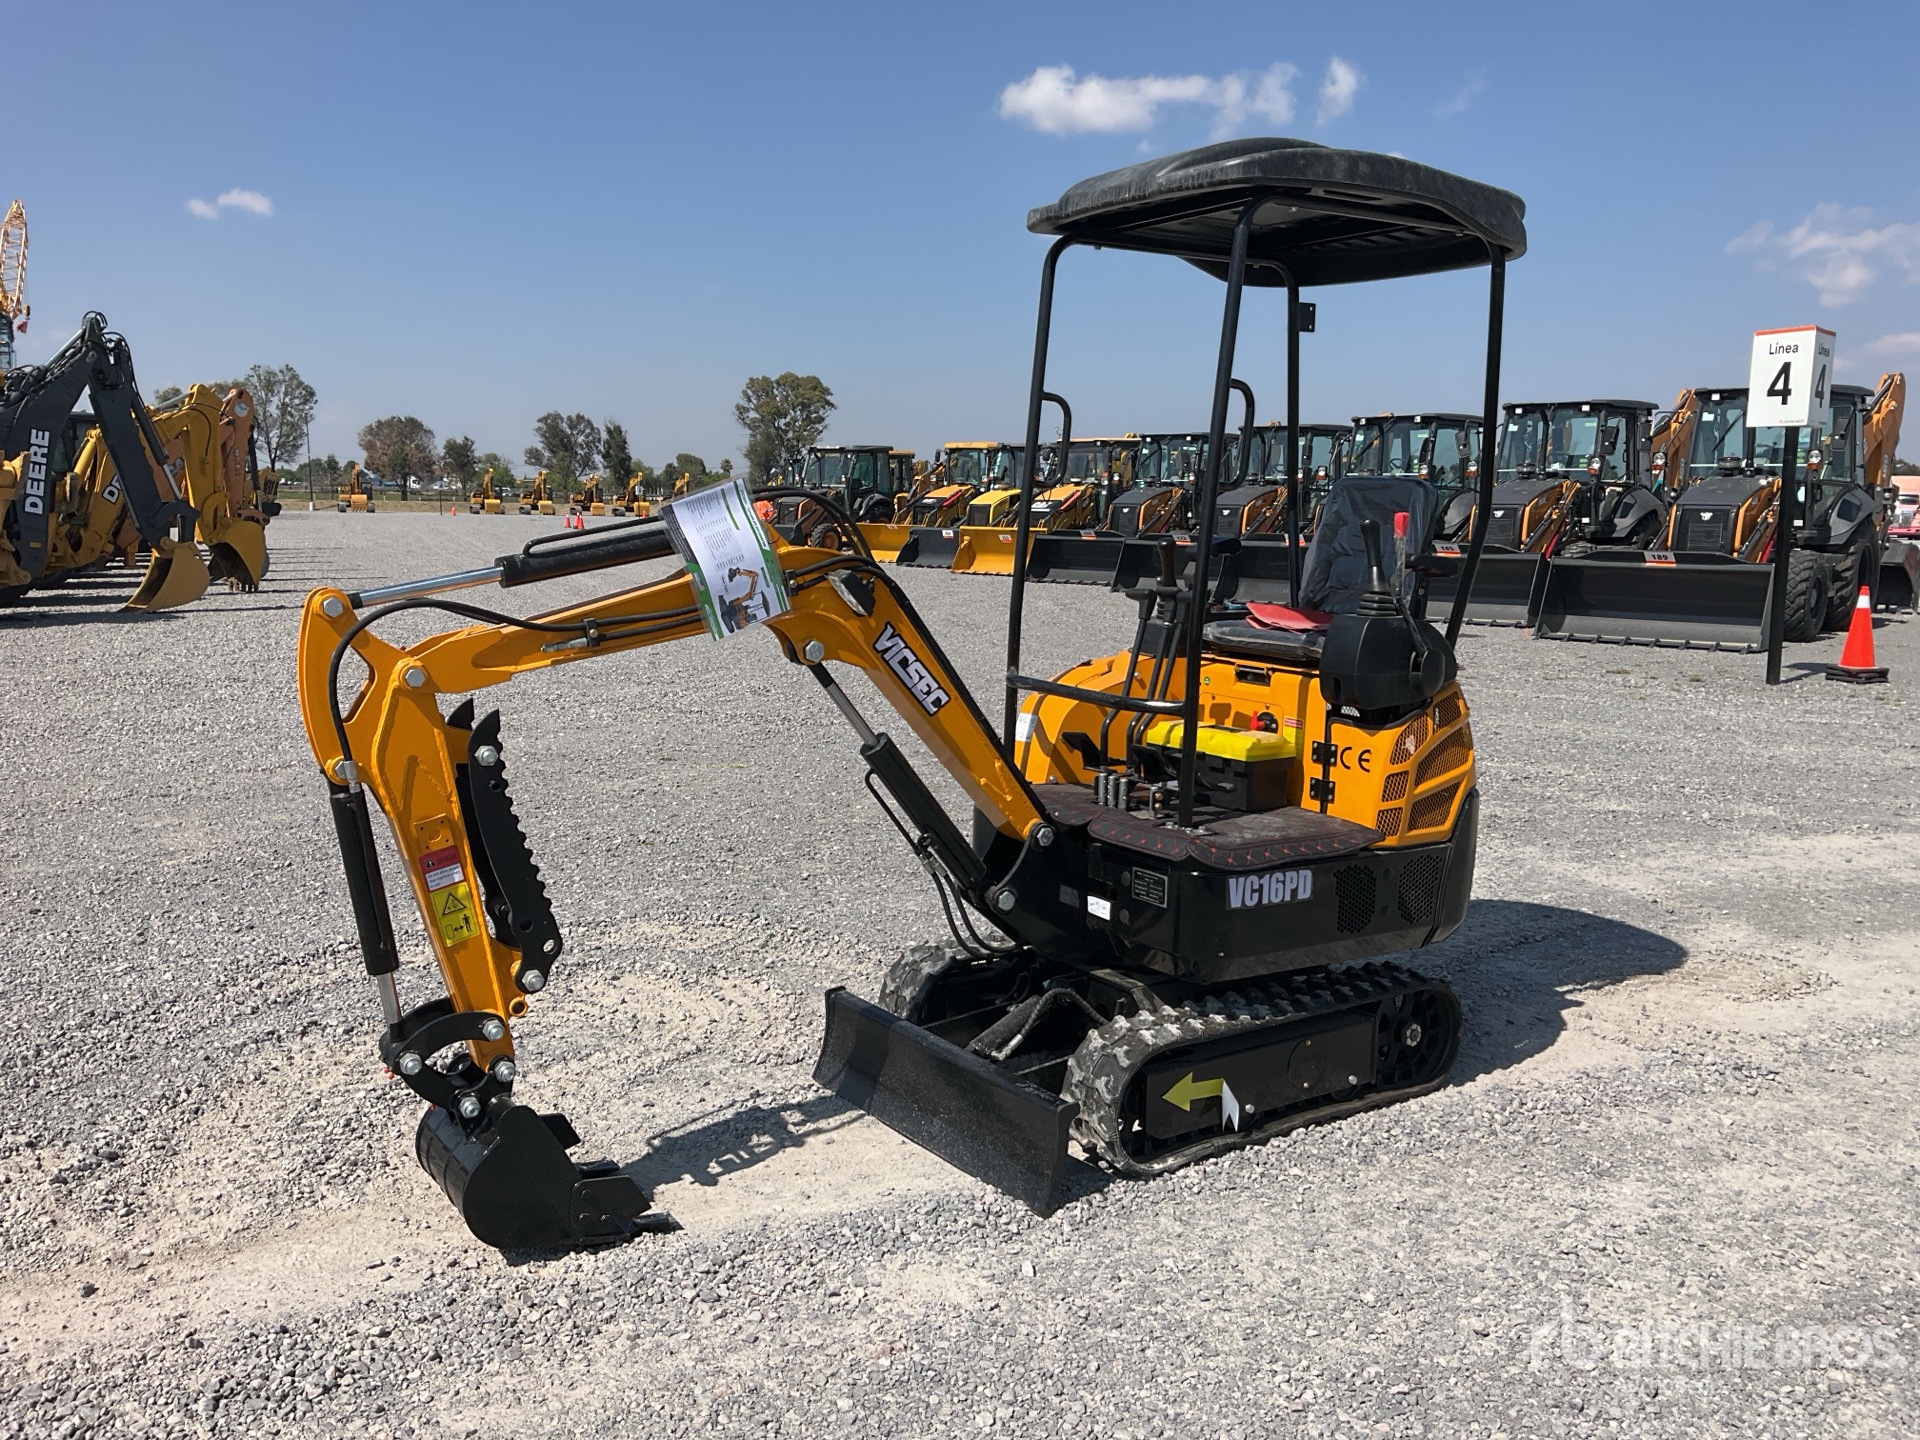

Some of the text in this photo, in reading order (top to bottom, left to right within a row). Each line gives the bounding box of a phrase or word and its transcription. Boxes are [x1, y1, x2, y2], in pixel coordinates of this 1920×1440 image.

[1768, 342, 1799, 355] Línea
[1766, 361, 1792, 405] 4
[1815, 364, 1826, 408] 4
[25, 429, 50, 515] DEERE
[874, 623, 950, 715] VICSEC
[1340, 746, 1371, 773] CE
[1229, 870, 1312, 908] VC16PD
